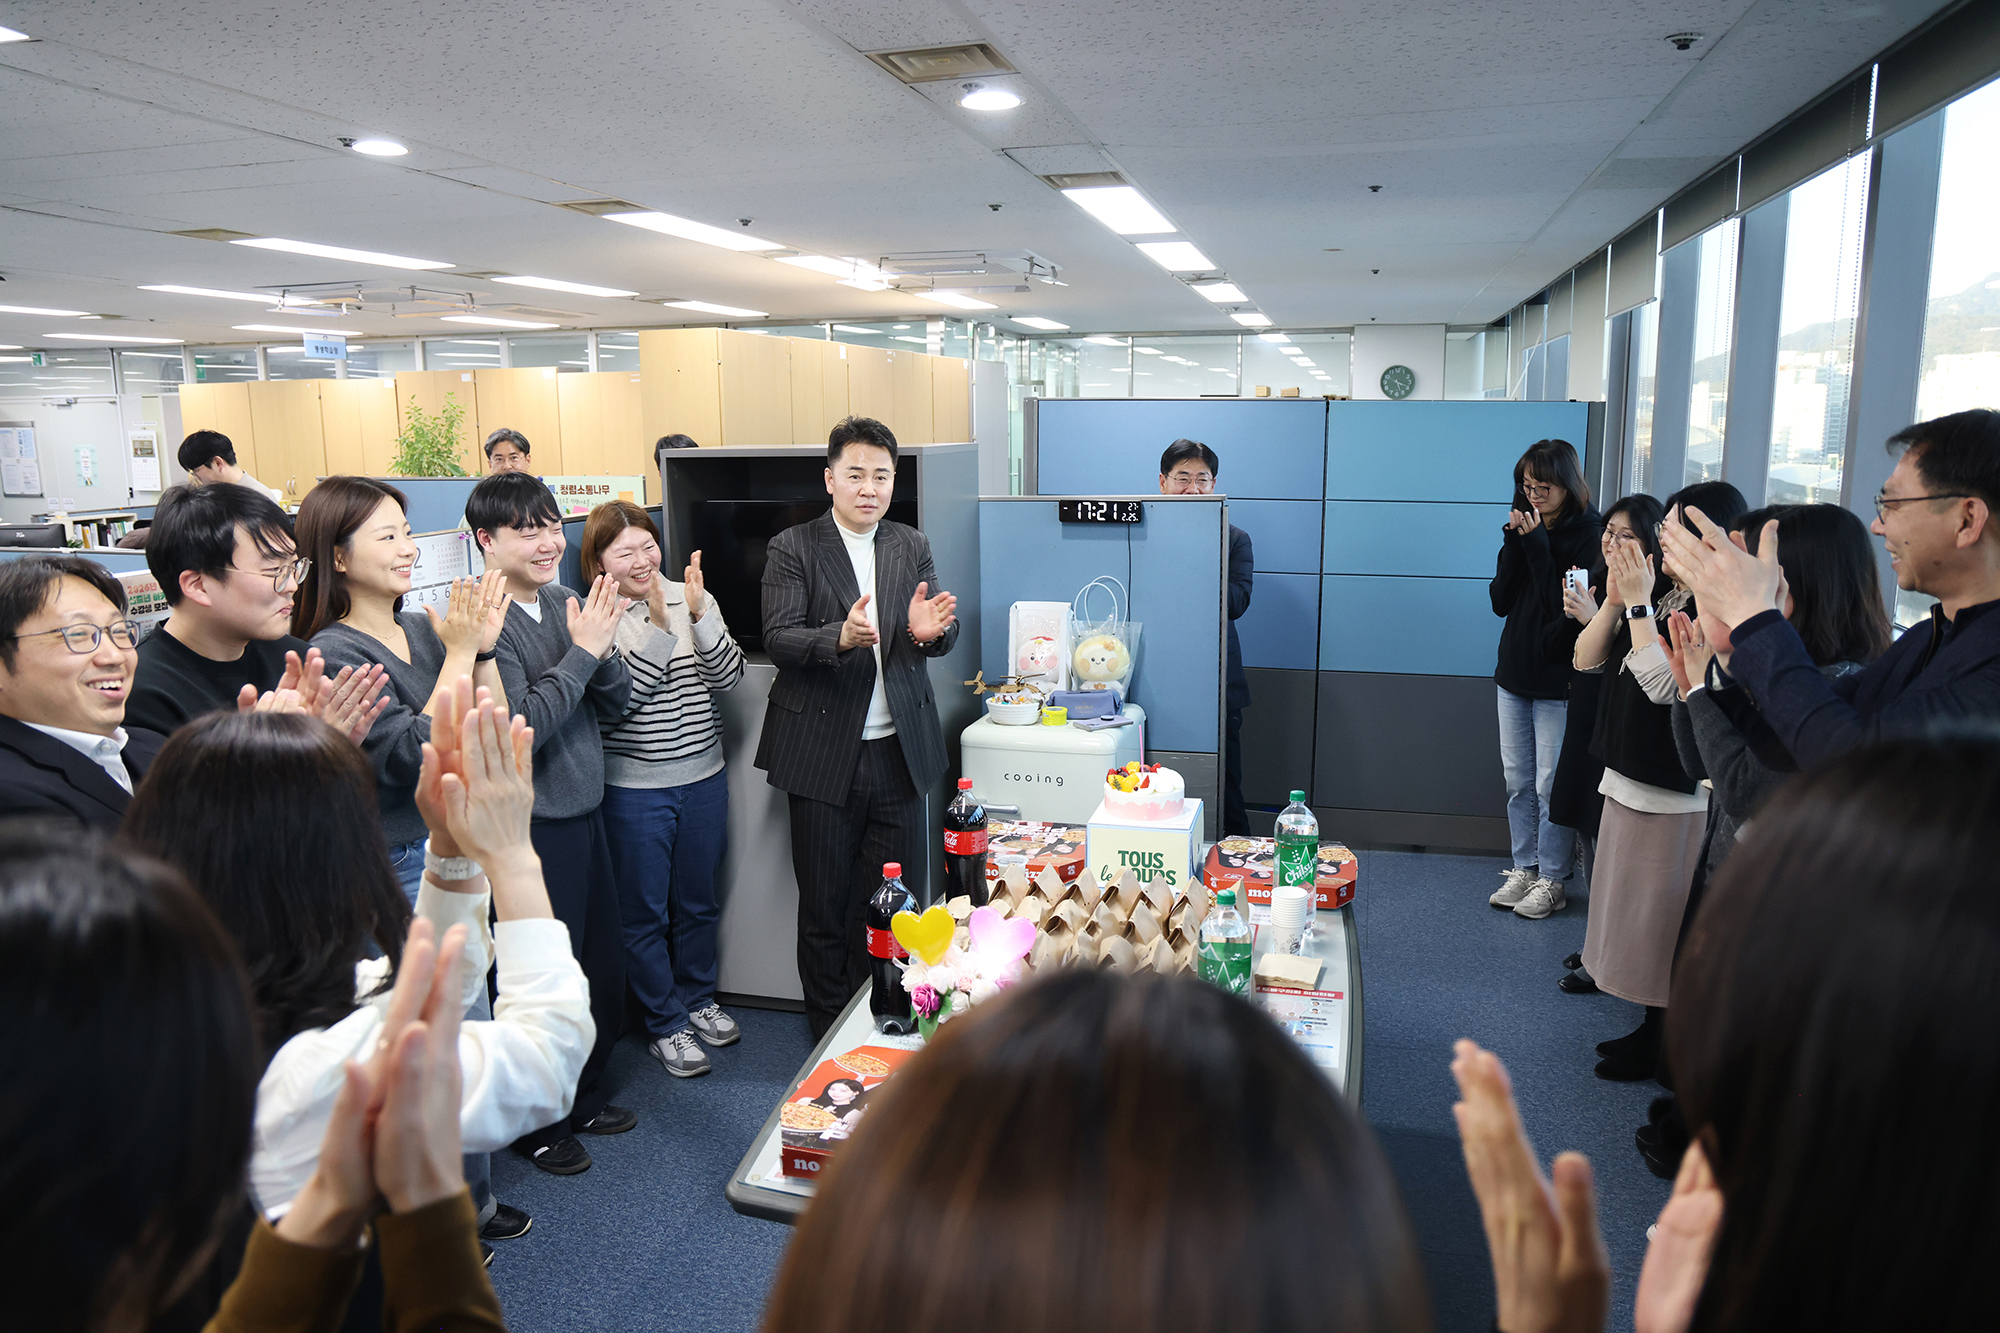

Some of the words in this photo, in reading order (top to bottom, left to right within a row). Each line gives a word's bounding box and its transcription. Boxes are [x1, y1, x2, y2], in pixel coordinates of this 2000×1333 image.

[560, 484, 610, 495] 청렴소통나무
[1077, 502, 1118, 521] 17:21
[413, 547, 423, 569] 2
[127, 582, 158, 595] 2026년
[418, 592, 424, 603] 4
[431, 589, 438, 601] 5
[444, 586, 451, 599] 6
[131, 604, 153, 616] 수강생
[1004, 773, 1064, 787] cooing
[1117, 850, 1164, 869] TOUS
[1100, 864, 1113, 882] le
